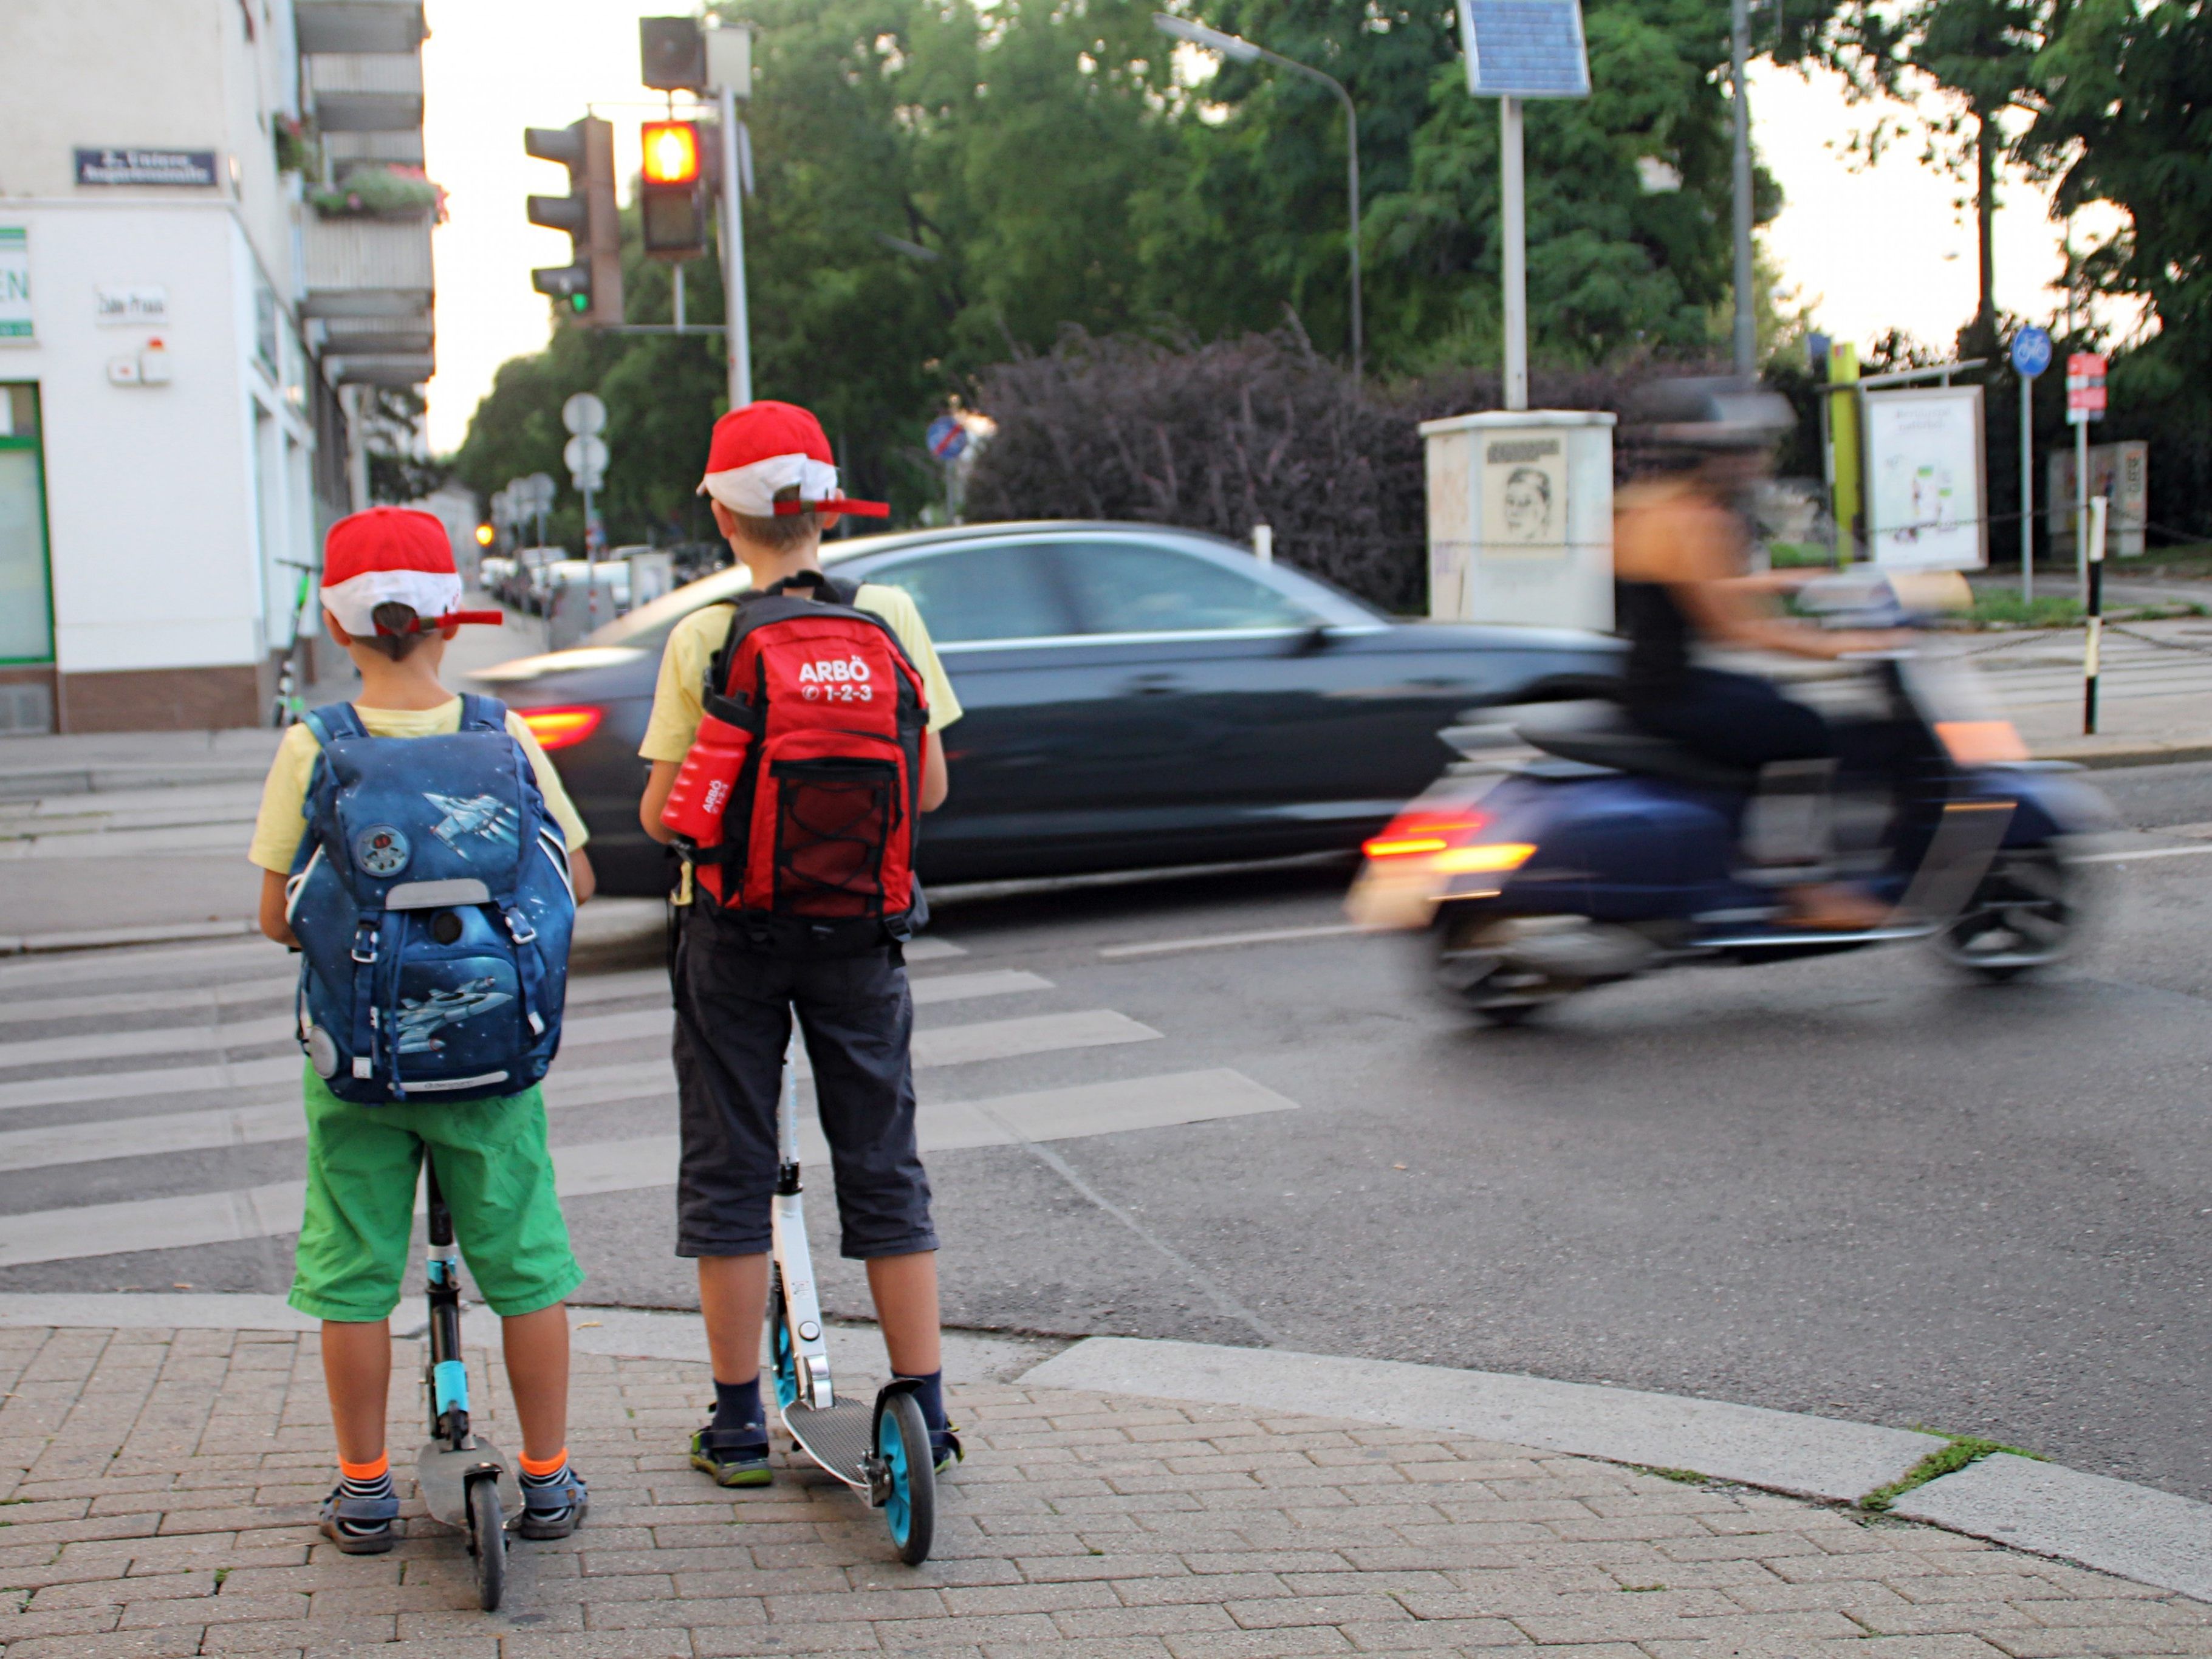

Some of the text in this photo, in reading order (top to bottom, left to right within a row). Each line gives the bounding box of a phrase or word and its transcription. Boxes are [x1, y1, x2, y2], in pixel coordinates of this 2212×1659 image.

[799, 655, 870, 682] ARBÖ
[824, 684, 873, 702] 1-2-3
[703, 780, 722, 813] ARBÖ
